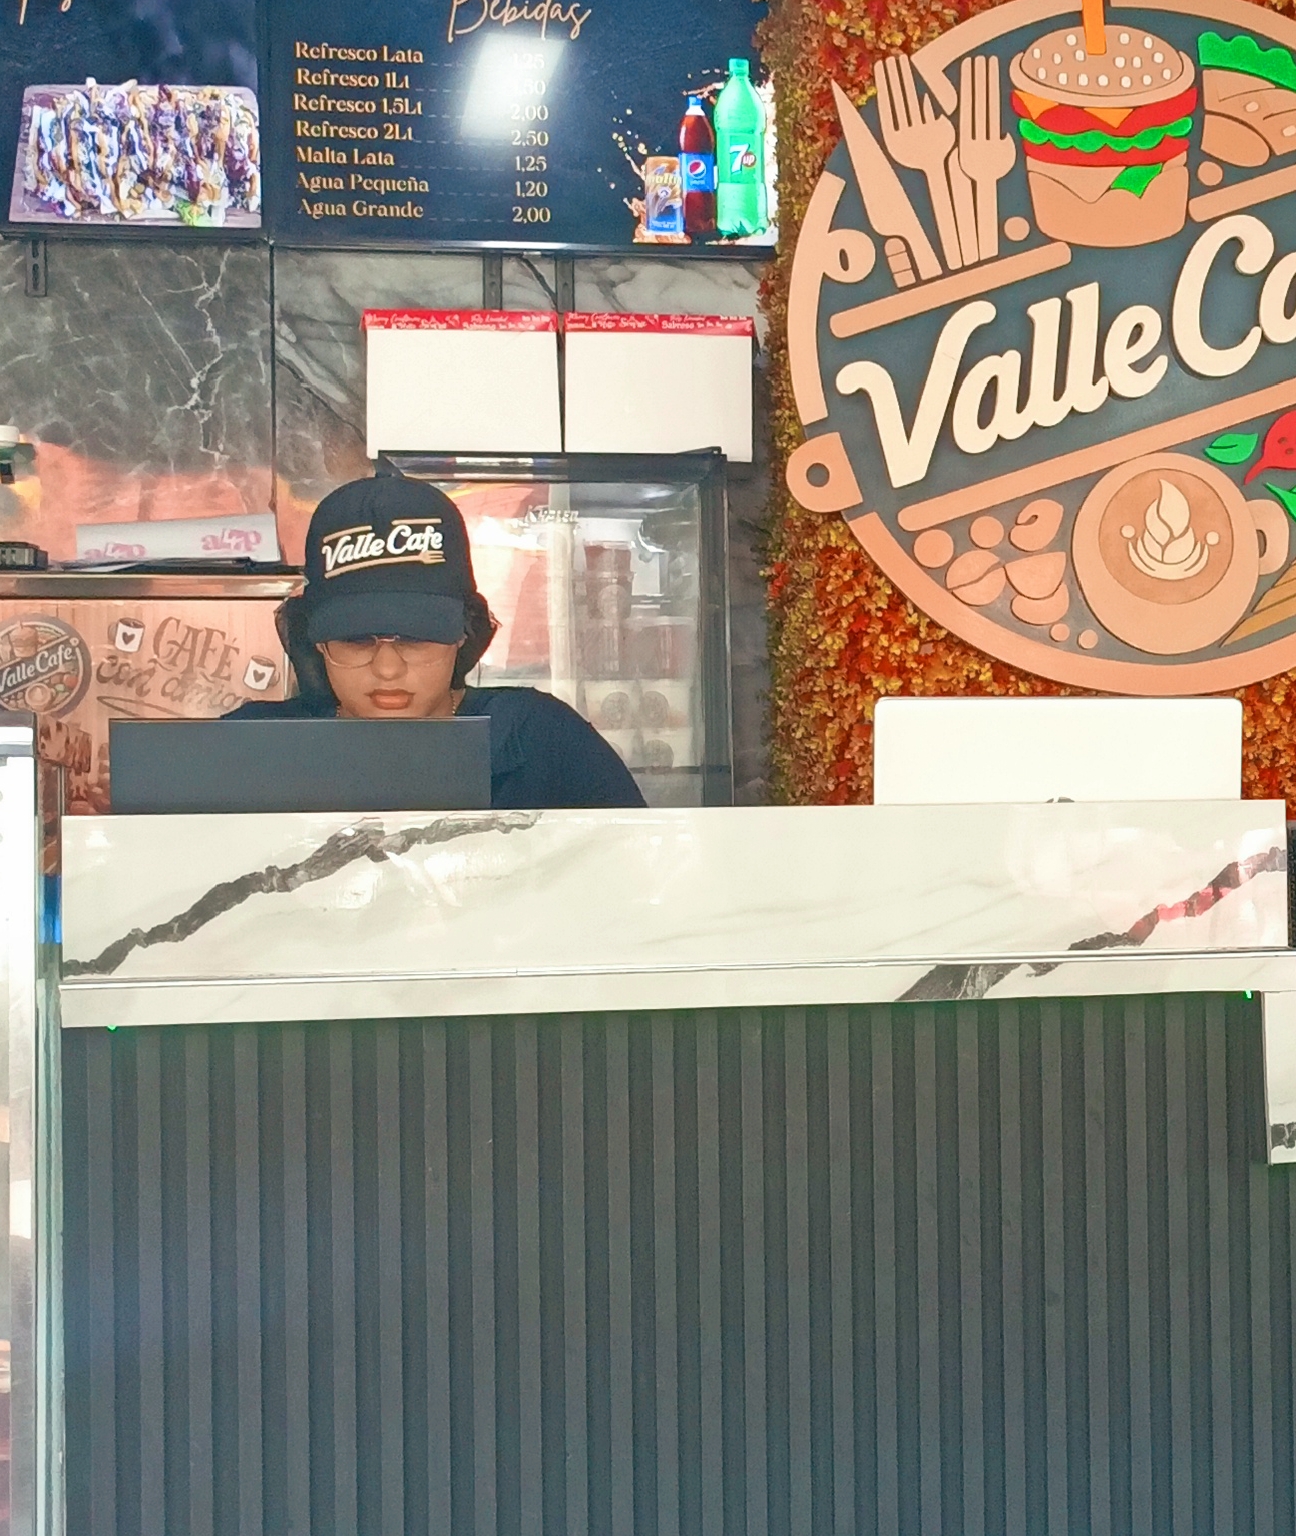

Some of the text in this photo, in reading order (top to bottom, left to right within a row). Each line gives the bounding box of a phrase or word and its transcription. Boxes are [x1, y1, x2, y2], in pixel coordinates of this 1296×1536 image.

[295, 41, 377, 62] Refresco
[382, 45, 423, 63] Lata
[296, 68, 379, 87] Refresco
[385, 71, 410, 88] 1Lt
[293, 93, 549, 121] Refresco 1,5Lt 2,00
[295, 120, 549, 146] Refresco 2Lt 2,50
[296, 145, 547, 172] Malta Lata 1,25
[296, 172, 548, 197] Agua Pequeña 1,20
[298, 198, 551, 223] Agua Grande 2,00
[321, 529, 385, 571] Valle
[152, 616, 240, 682] CAFÉ
